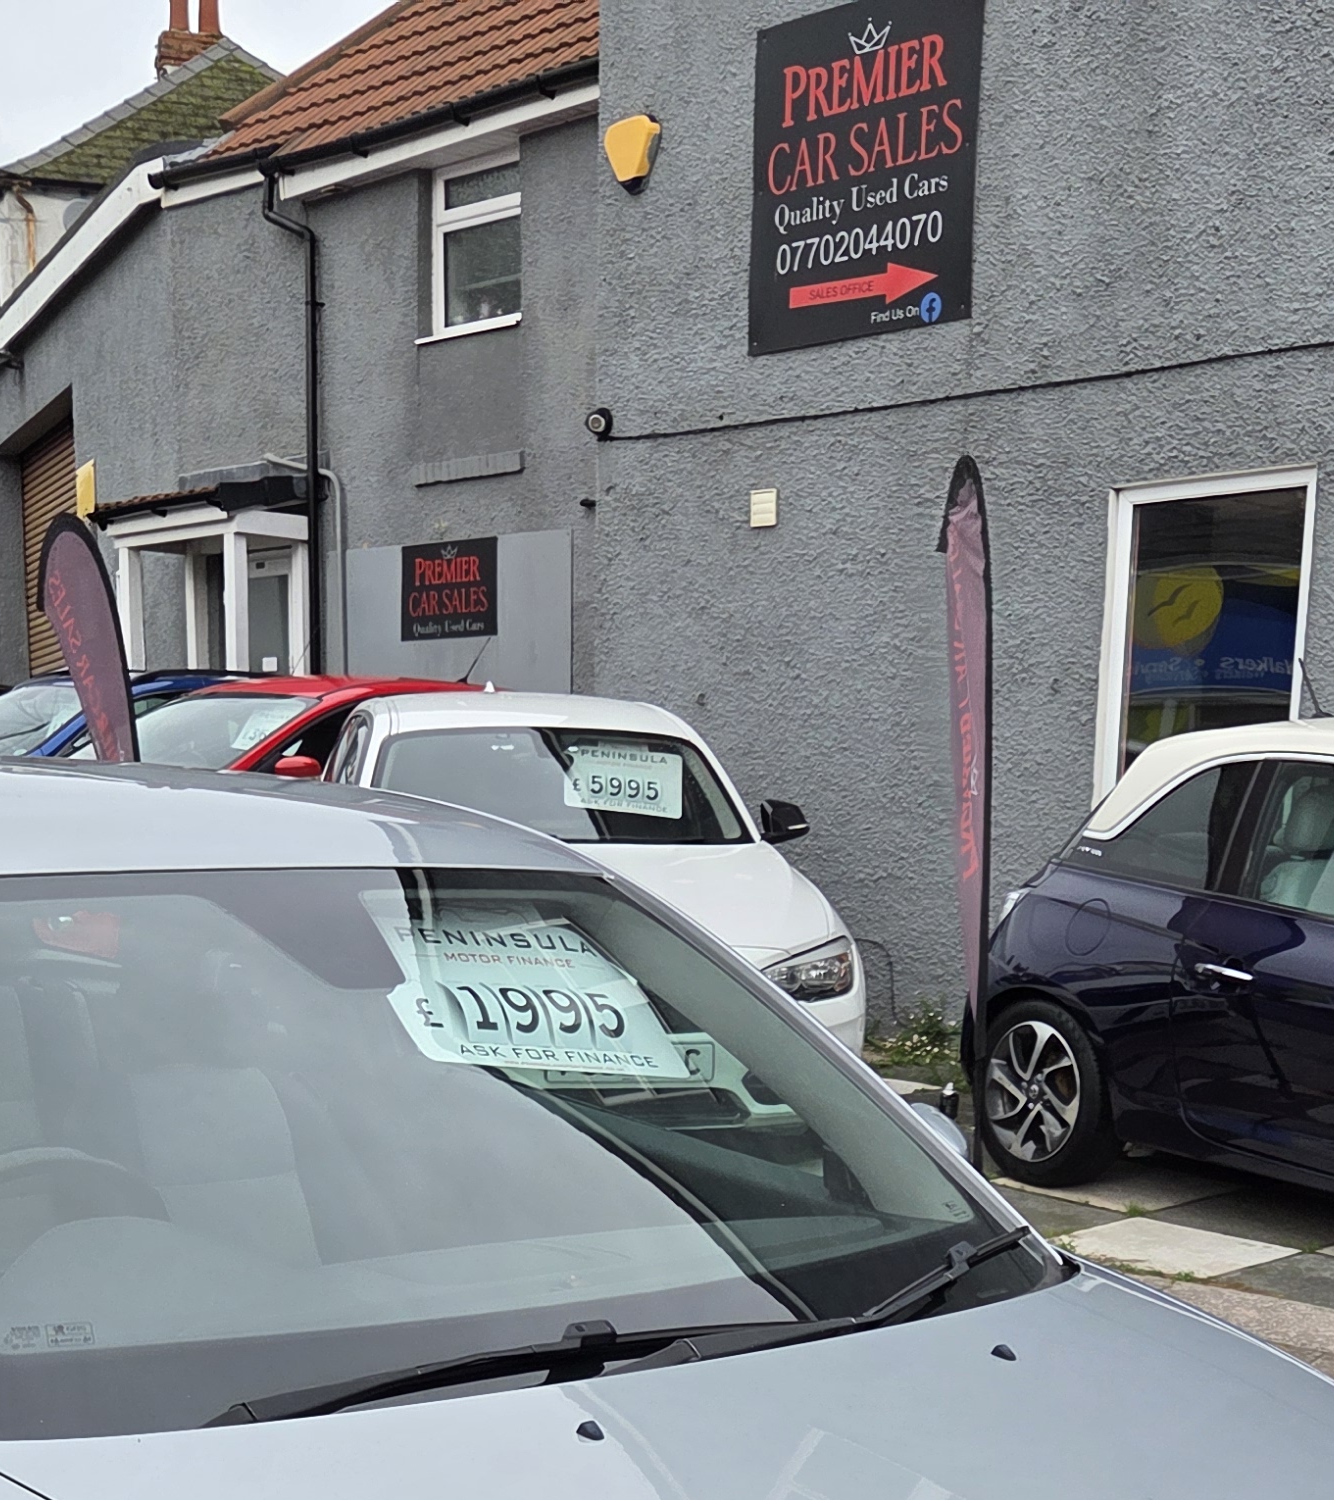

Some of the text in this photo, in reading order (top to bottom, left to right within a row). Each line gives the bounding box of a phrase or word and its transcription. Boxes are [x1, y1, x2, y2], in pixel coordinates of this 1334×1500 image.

[781, 34, 947, 128] PREMIER
[768, 99, 963, 195] CAR SALES
[774, 173, 949, 233] Quality Used Cars
[776, 211, 943, 275] 07702044070
[808, 281, 875, 301] SALES OFFICE
[870, 312, 890, 324] Find
[891, 308, 904, 319] Us
[906, 306, 920, 317] On
[415, 556, 480, 586] PREMIER
[409, 586, 488, 617] CAR SALES
[413, 621, 442, 637] Quality
[466, 619, 484, 631] Cars
[580, 749, 667, 765] PENINSULA
[572, 775, 659, 801] £ 5995
[393, 926, 598, 957] PENINSULA
[443, 951, 576, 969] MOTOR FINANCE
[416, 985, 625, 1039] £ 1995
[460, 1043, 507, 1059] ASK
[512, 1046, 557, 1063] FOR
[566, 1050, 659, 1069] FINANCE
